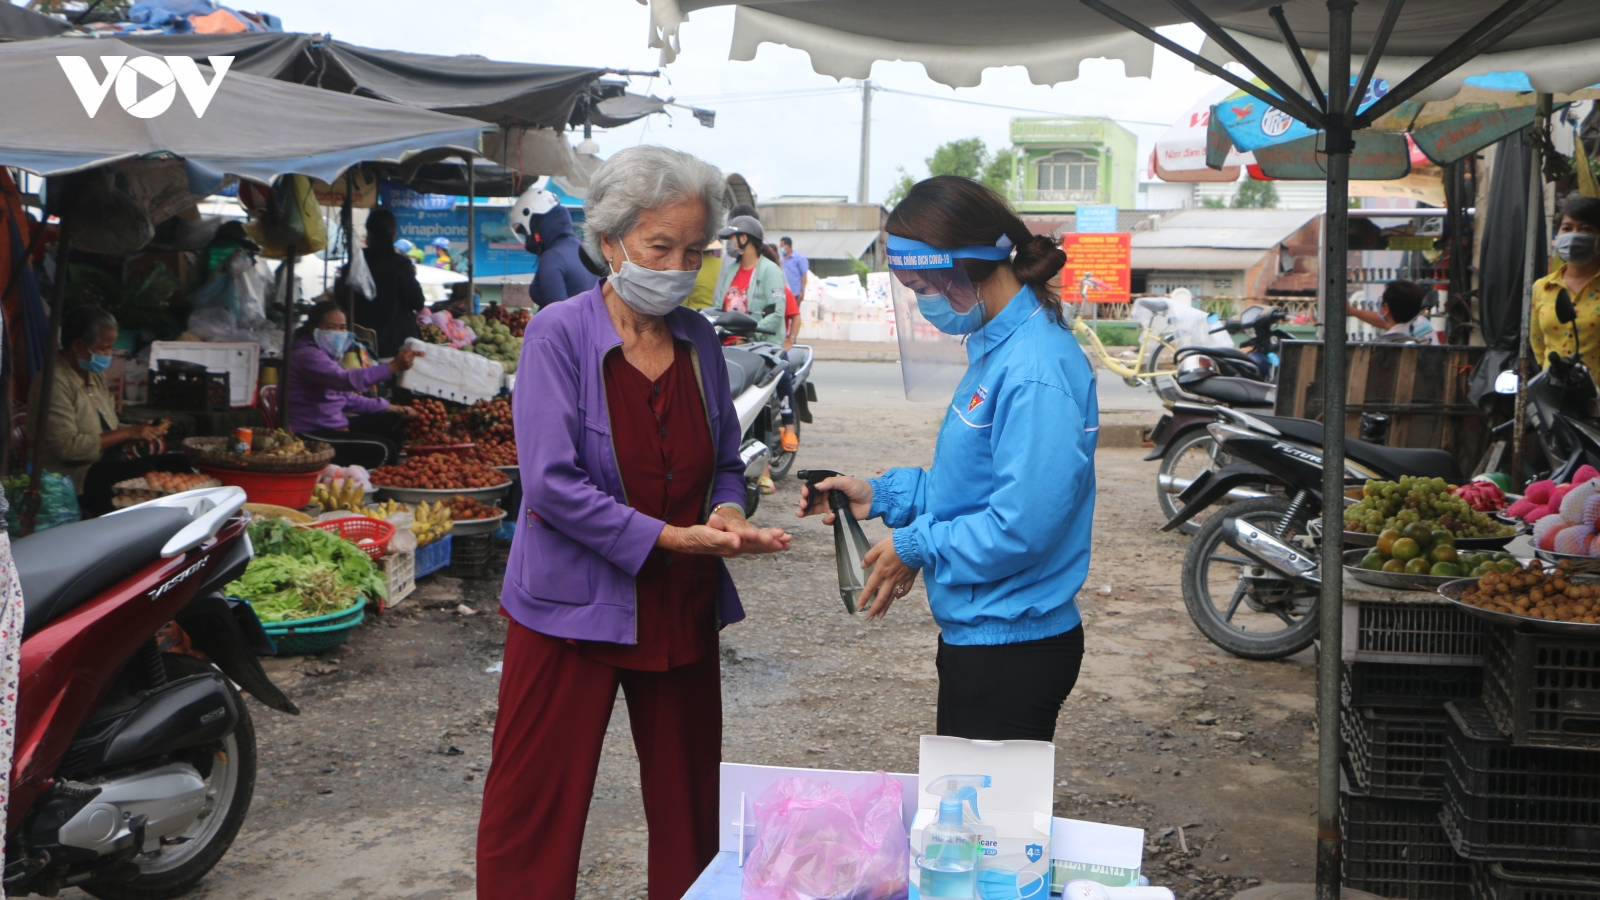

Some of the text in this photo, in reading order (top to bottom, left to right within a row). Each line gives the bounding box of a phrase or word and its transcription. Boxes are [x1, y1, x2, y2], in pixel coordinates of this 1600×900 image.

[430, 198, 447, 208] 777
[399, 222, 468, 237] vinaphone
[917, 254, 929, 268] DỊCH
[928, 253, 950, 265] COVID-19
[1272, 442, 1322, 463] FUTUR
[147, 554, 210, 601] VISION
[1026, 847, 1034, 858] 4
